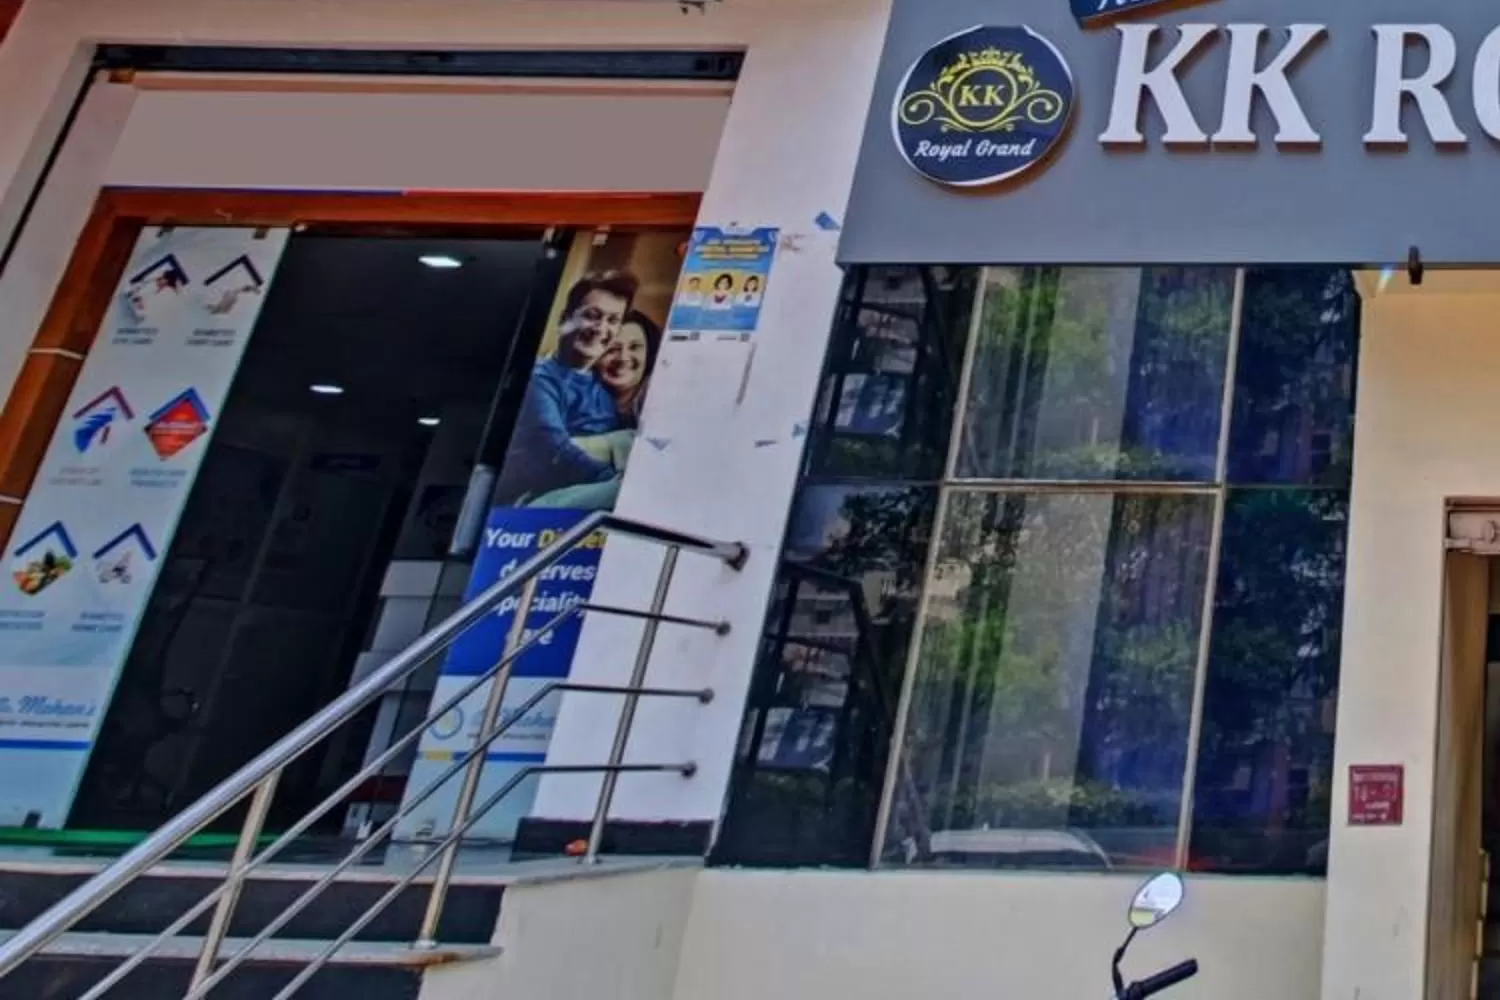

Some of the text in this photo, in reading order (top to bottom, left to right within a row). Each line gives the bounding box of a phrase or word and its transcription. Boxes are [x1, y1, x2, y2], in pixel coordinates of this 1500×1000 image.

[1097, 23, 1327, 145] KK
[958, 85, 1006, 107] KK
[913, 138, 1037, 161] Royal Grand
[486, 528, 536, 548] Your
